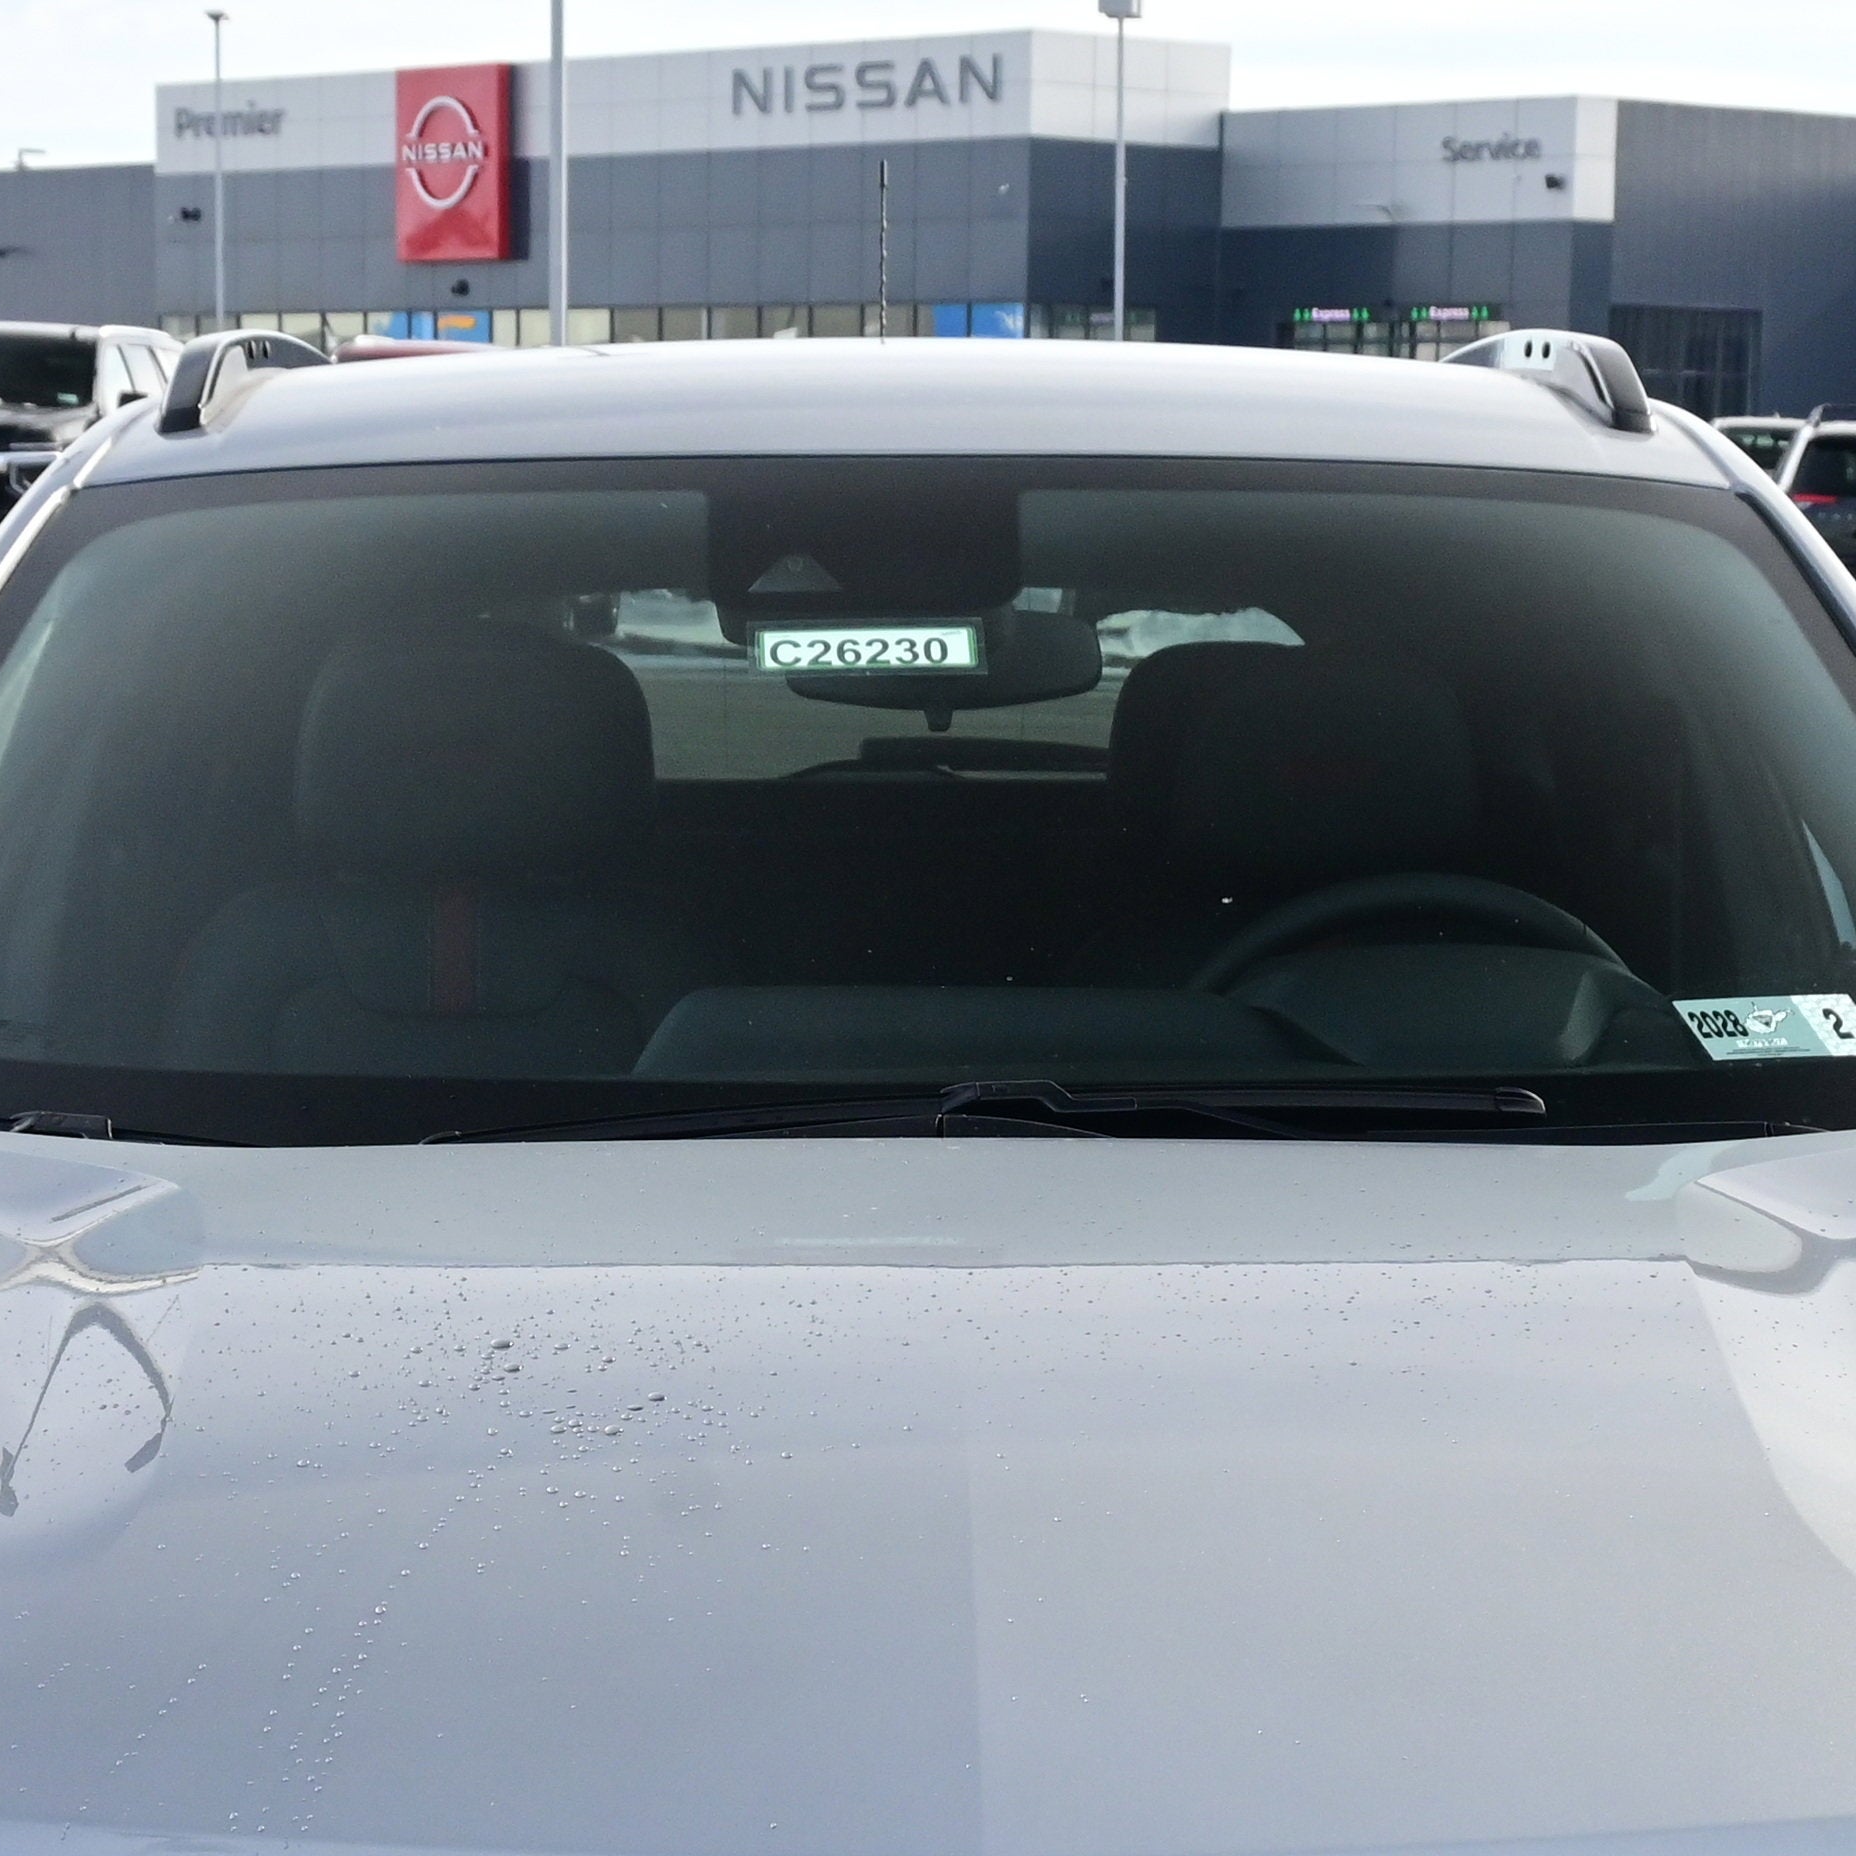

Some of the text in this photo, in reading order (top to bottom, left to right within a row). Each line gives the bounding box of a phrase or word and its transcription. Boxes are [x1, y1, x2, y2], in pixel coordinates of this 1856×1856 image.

[731, 53, 1004, 115] NISSAN
[175, 98, 285, 138] Premier
[402, 141, 483, 163] NISSAN
[1442, 131, 1542, 162] Service
[769, 637, 949, 666] C26230
[1687, 1009, 1750, 1040] 2028
[1822, 1008, 1855, 1040] 2
